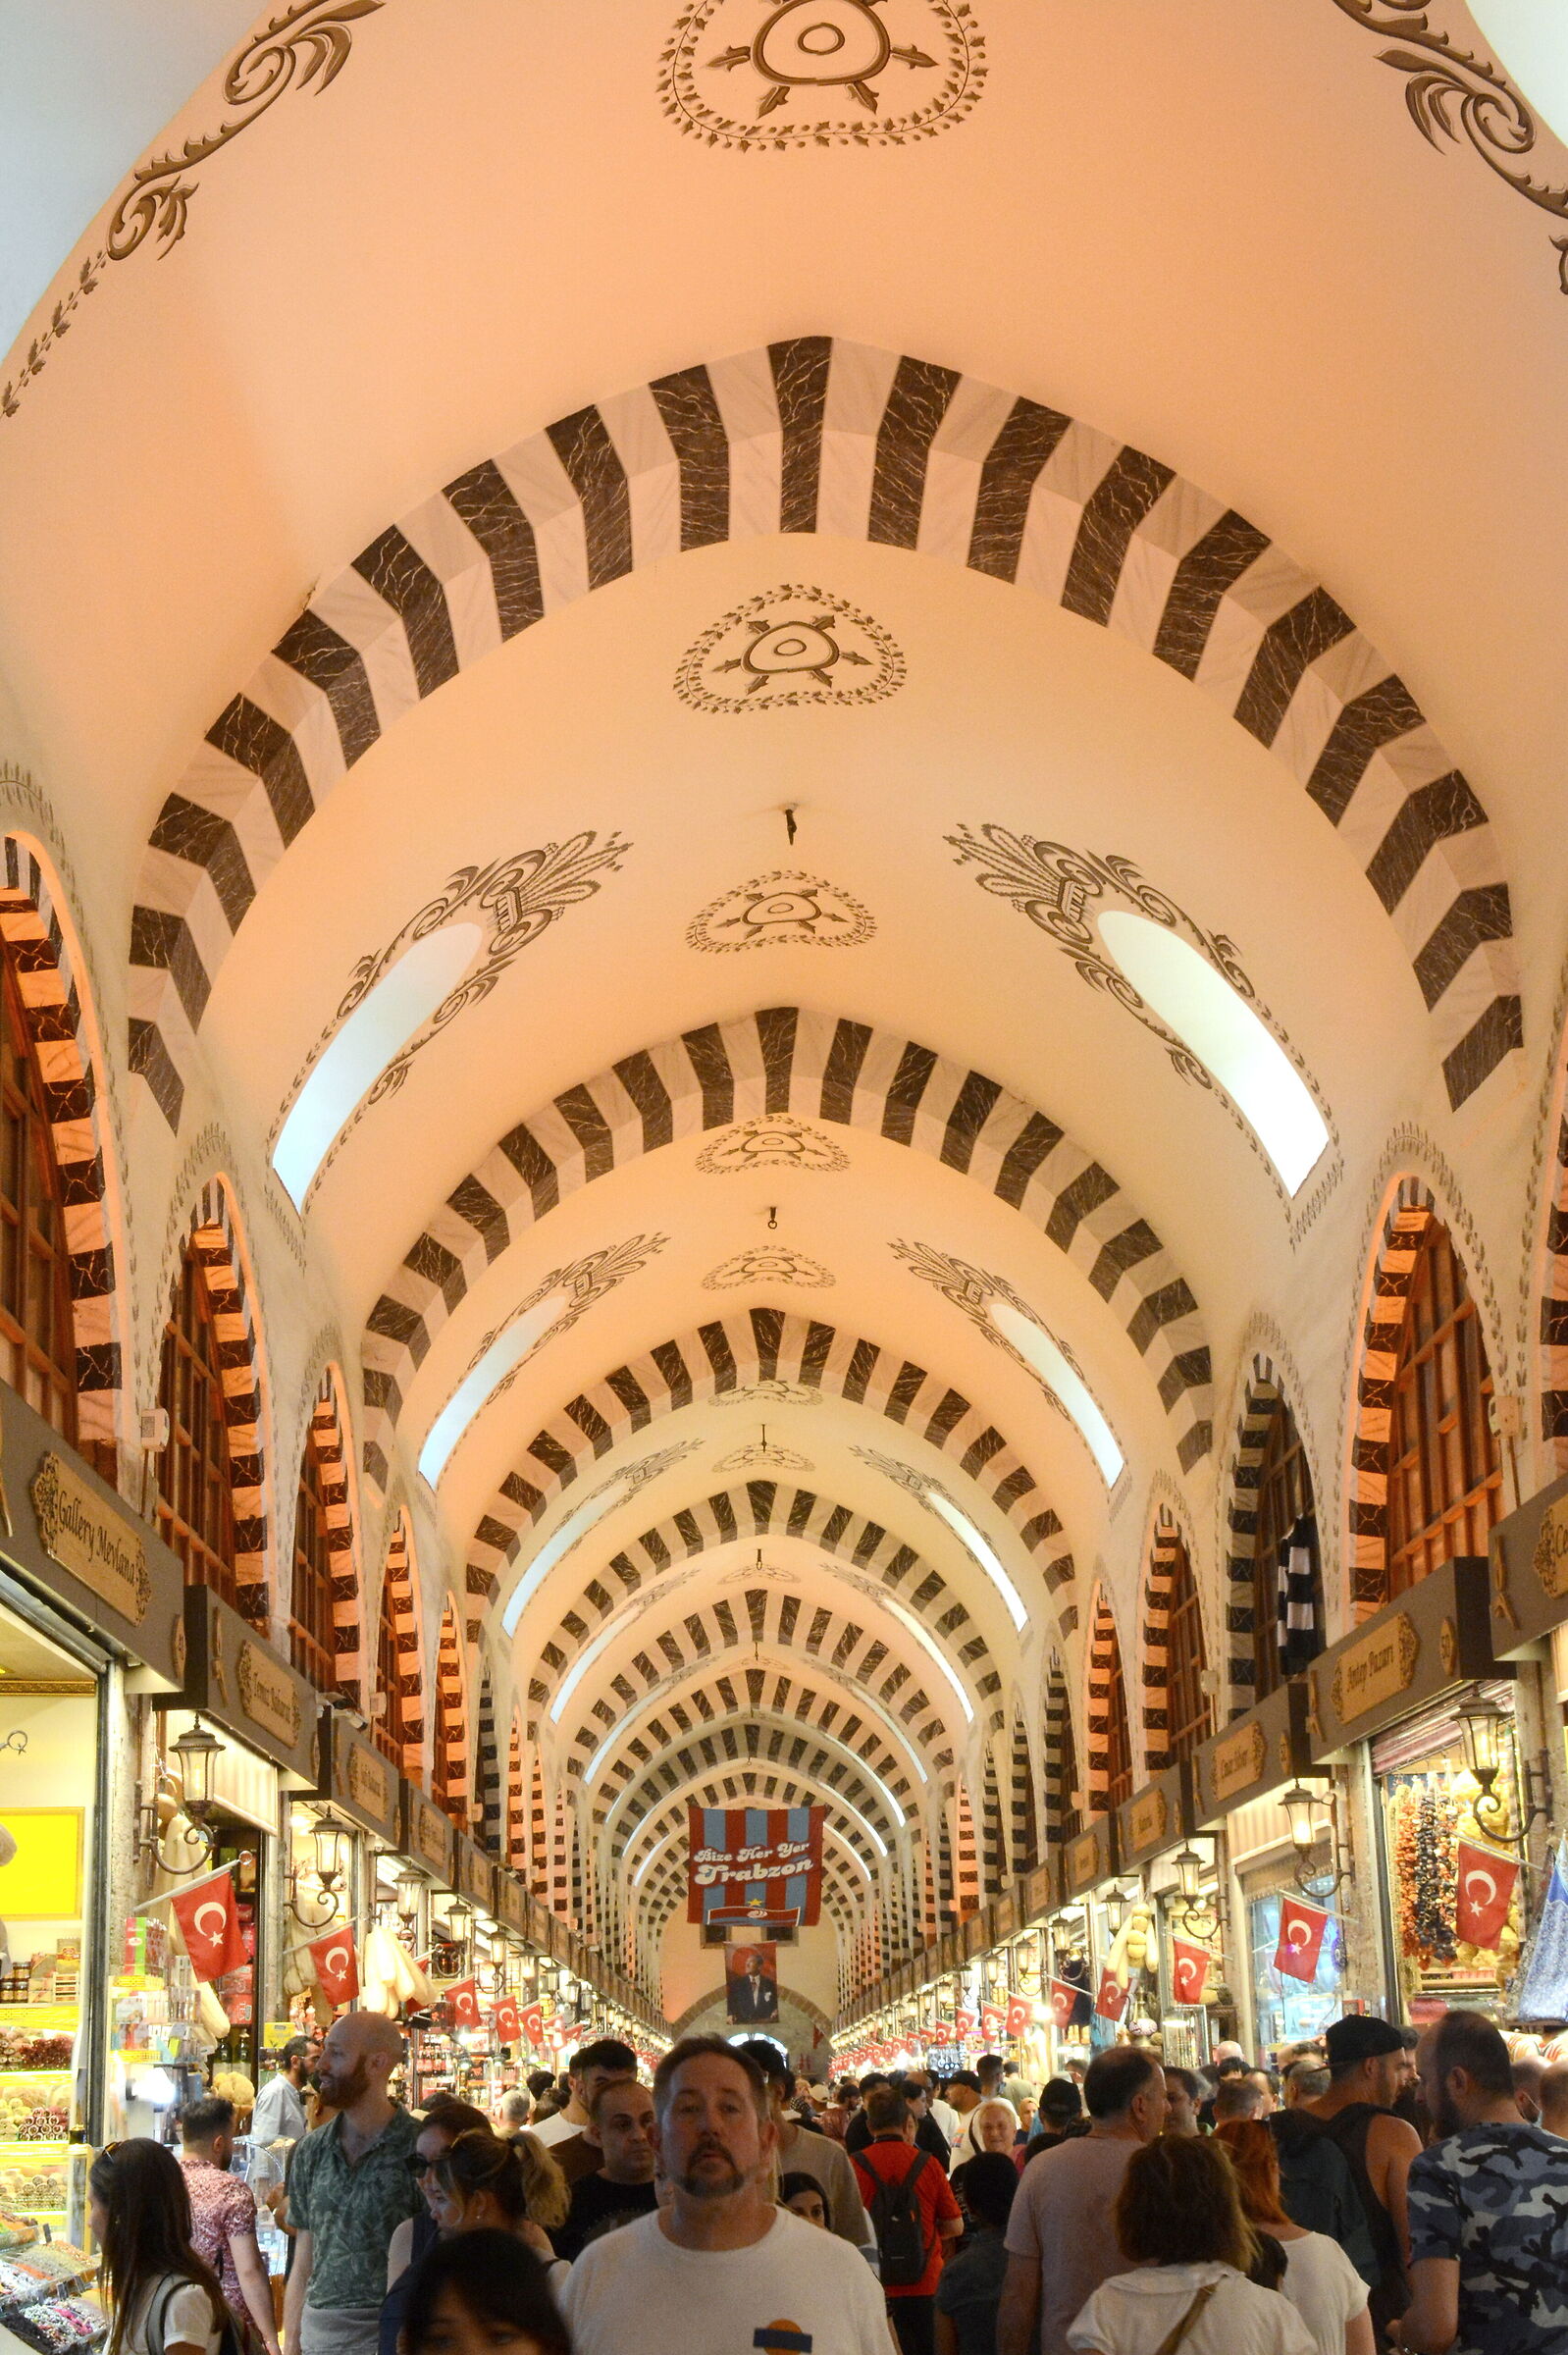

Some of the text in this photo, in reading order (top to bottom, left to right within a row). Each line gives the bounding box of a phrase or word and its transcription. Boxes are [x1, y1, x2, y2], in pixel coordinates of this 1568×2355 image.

[59, 1491, 135, 1587] Gallery Mevlana
[693, 1842, 810, 1862] Bize Her Yer
[694, 1858, 813, 1885] Trabzon
